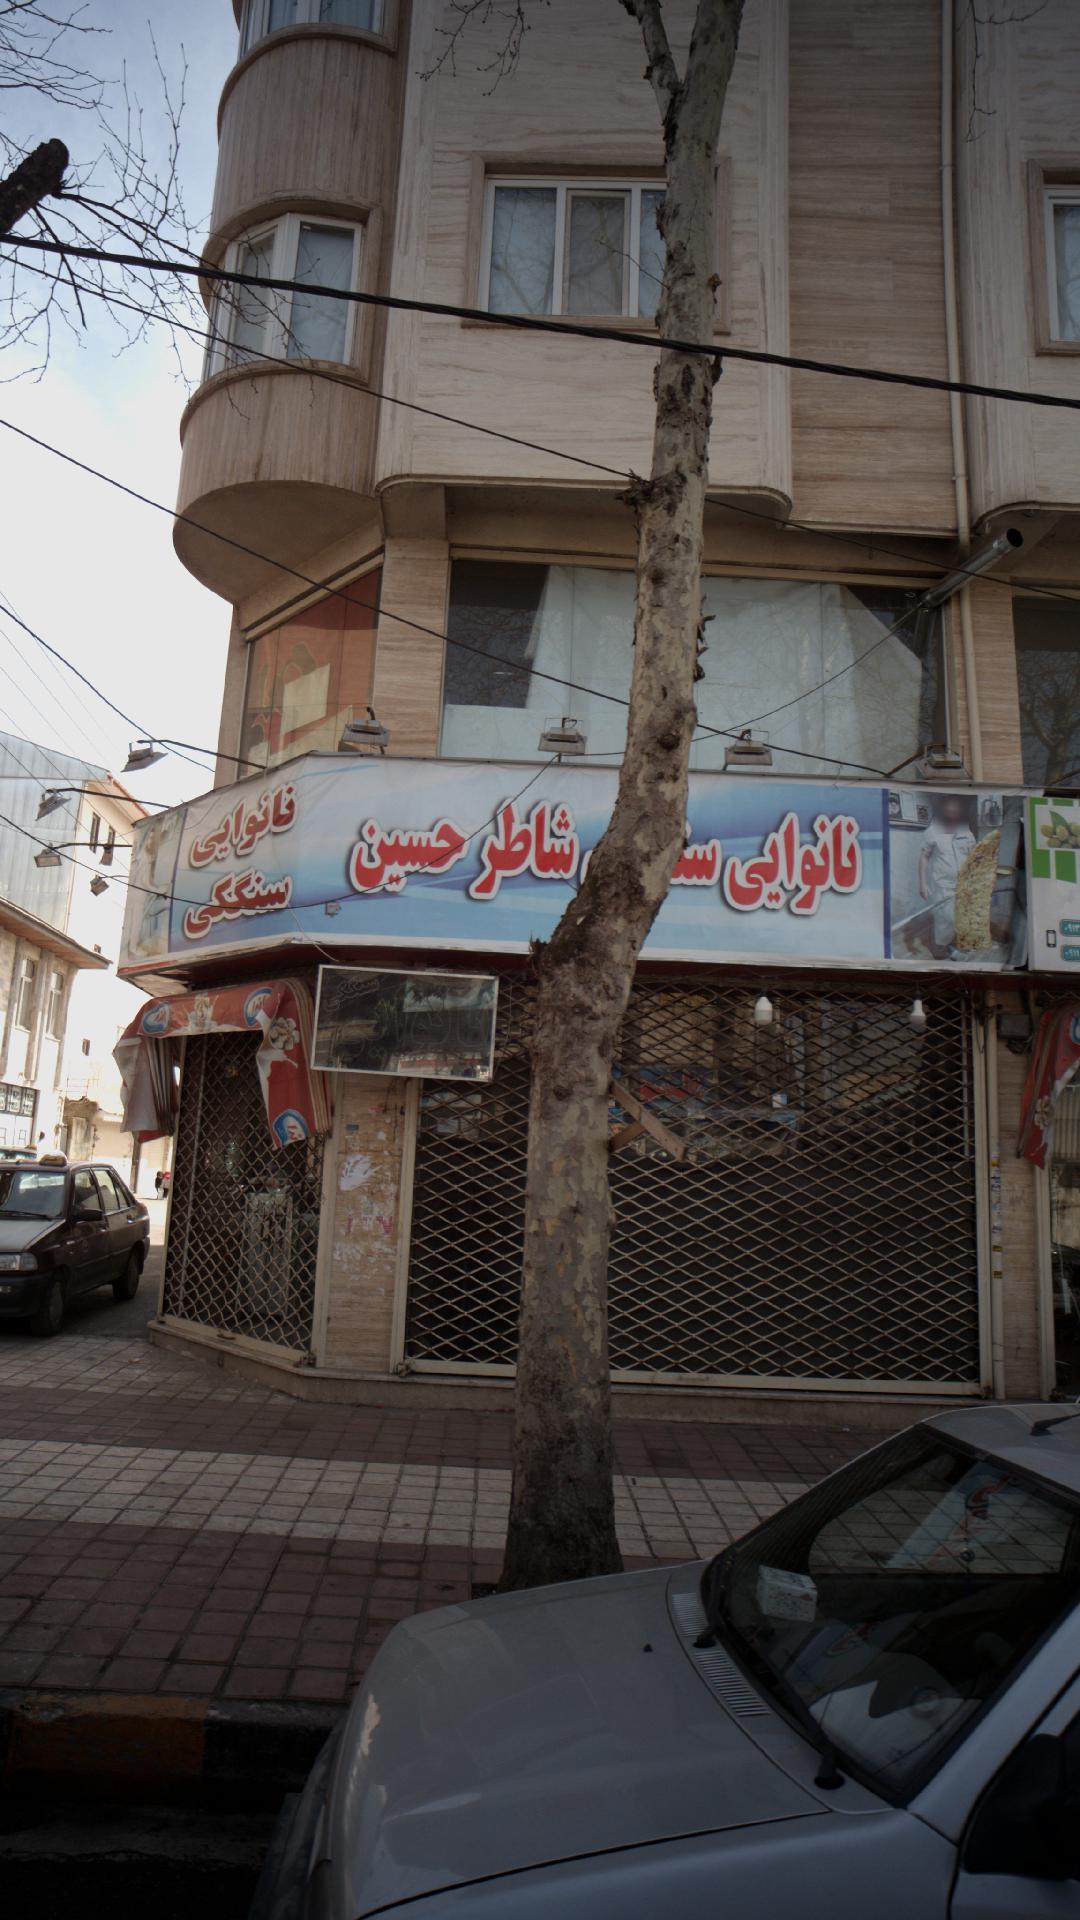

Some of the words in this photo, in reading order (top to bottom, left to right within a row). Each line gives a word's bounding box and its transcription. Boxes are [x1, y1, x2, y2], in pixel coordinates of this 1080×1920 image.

[191, 785, 297, 867] نانوایی
[351, 818, 471, 892] حسین
[469, 799, 579, 899] شاطر
[724, 813, 860, 914] نانوایی
[184, 869, 292, 938] سنگکی
